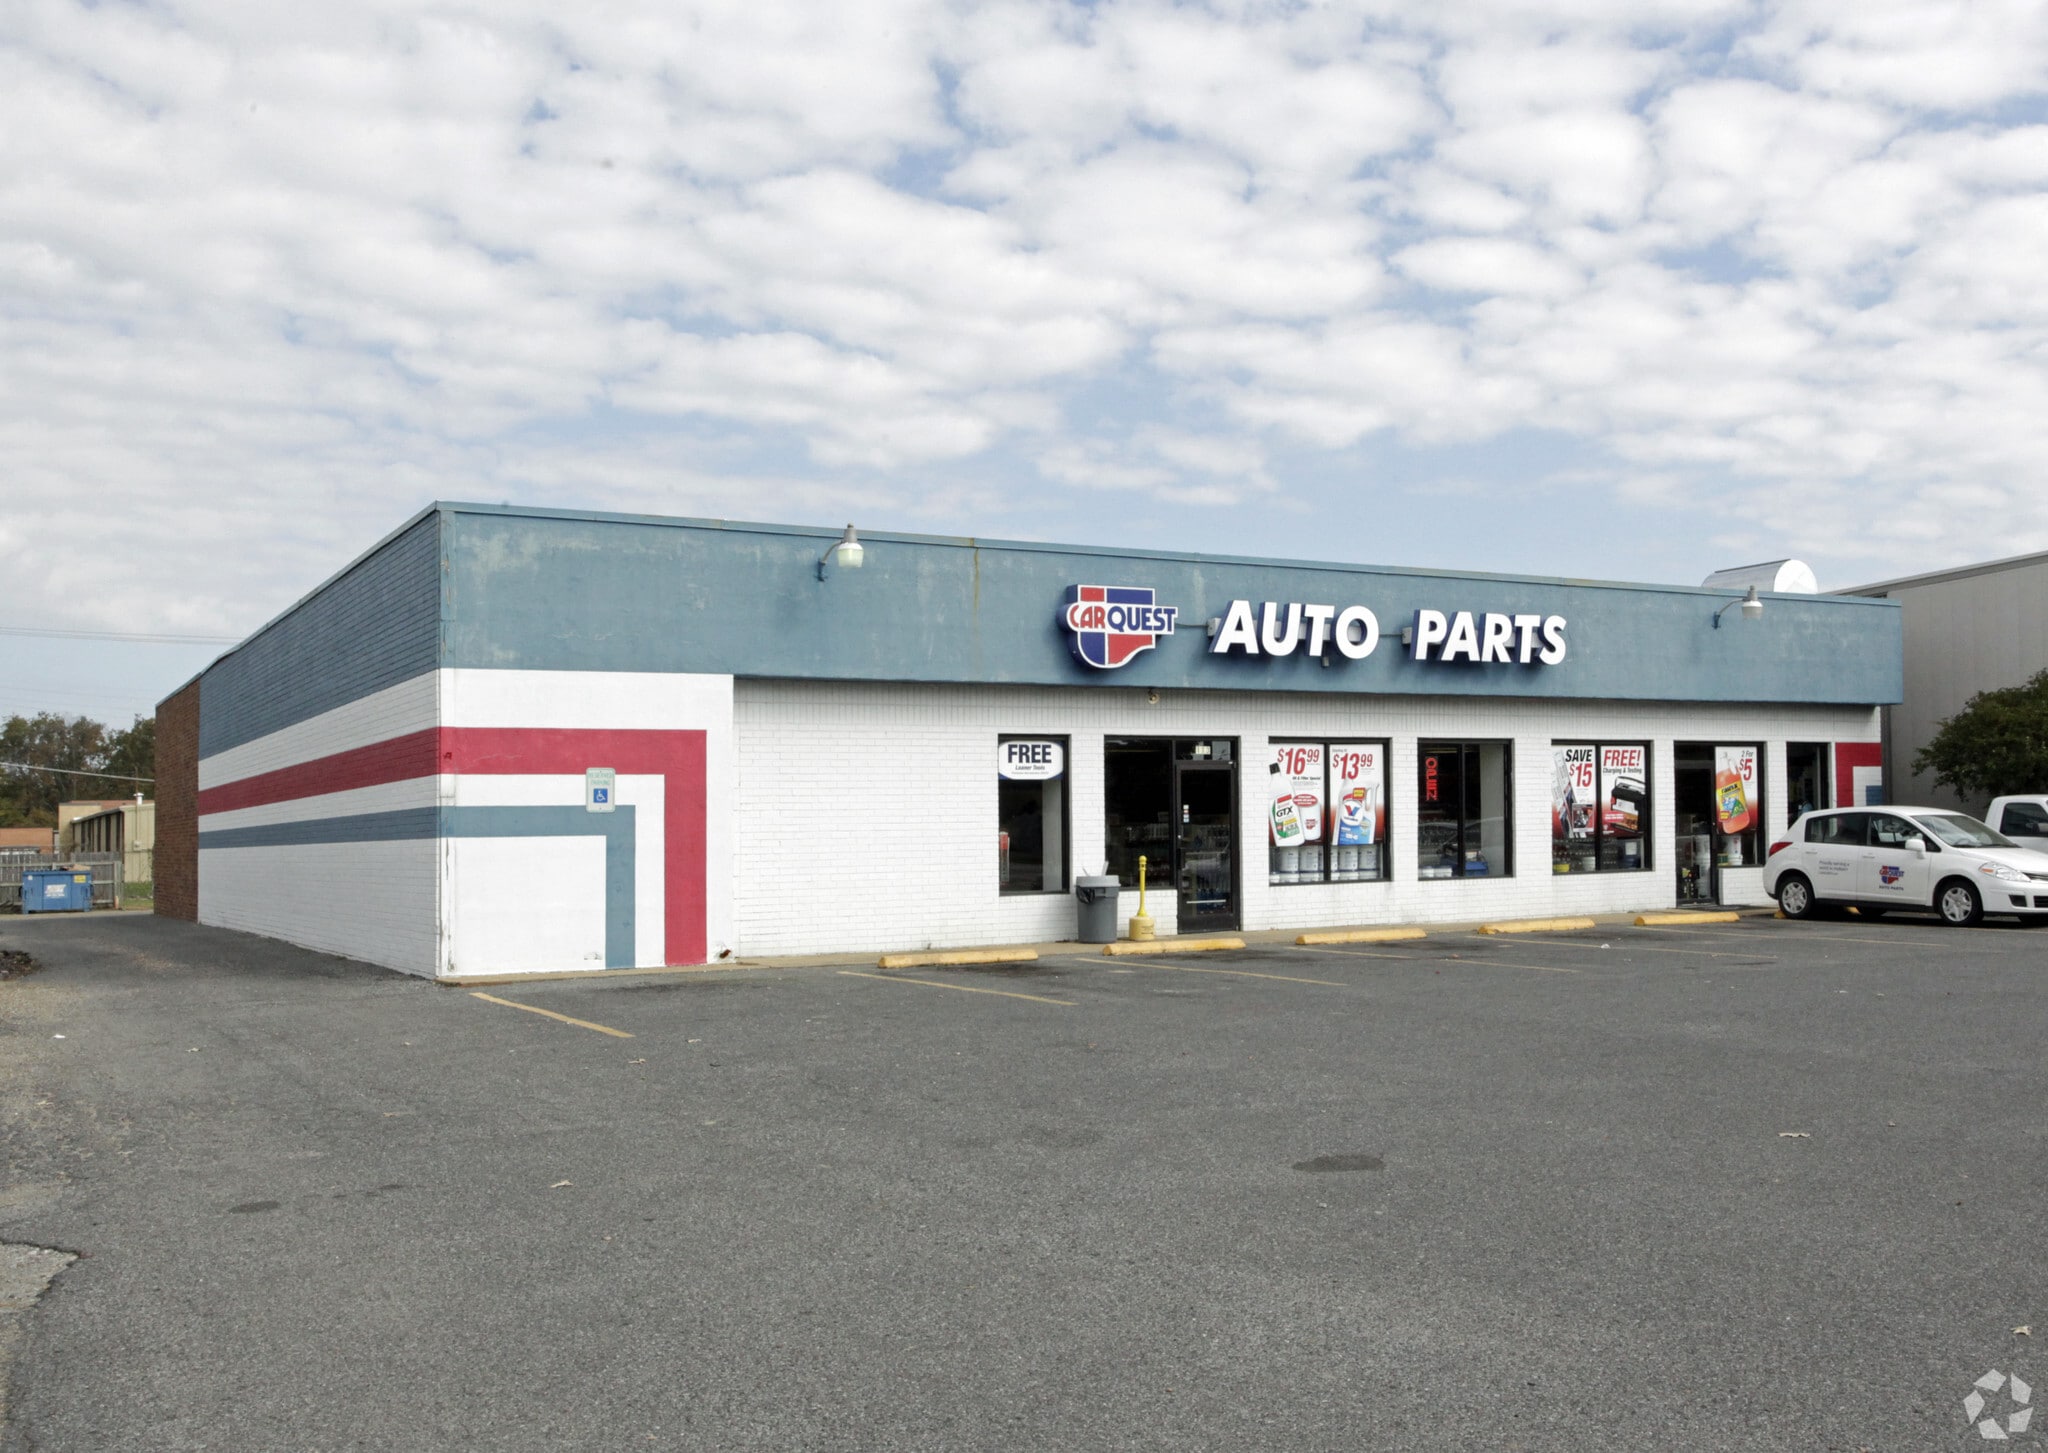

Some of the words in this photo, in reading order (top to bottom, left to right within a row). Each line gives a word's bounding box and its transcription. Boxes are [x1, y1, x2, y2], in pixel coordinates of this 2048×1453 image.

[1069, 604, 1176, 632] CARQUEST
[1212, 599, 1379, 660] AUTO
[1414, 608, 1567, 665] PARTS
[1007, 743, 1052, 764] FREE
[1565, 748, 1593, 763] SAVE
[1603, 749, 1642, 767] FREE!
[1741, 750, 1746, 758] 2
[1425, 757, 1438, 801] OPEN
[1568, 762, 1593, 788] $15
[1739, 758, 1753, 781] $5
[1276, 805, 1293, 818] GTX
